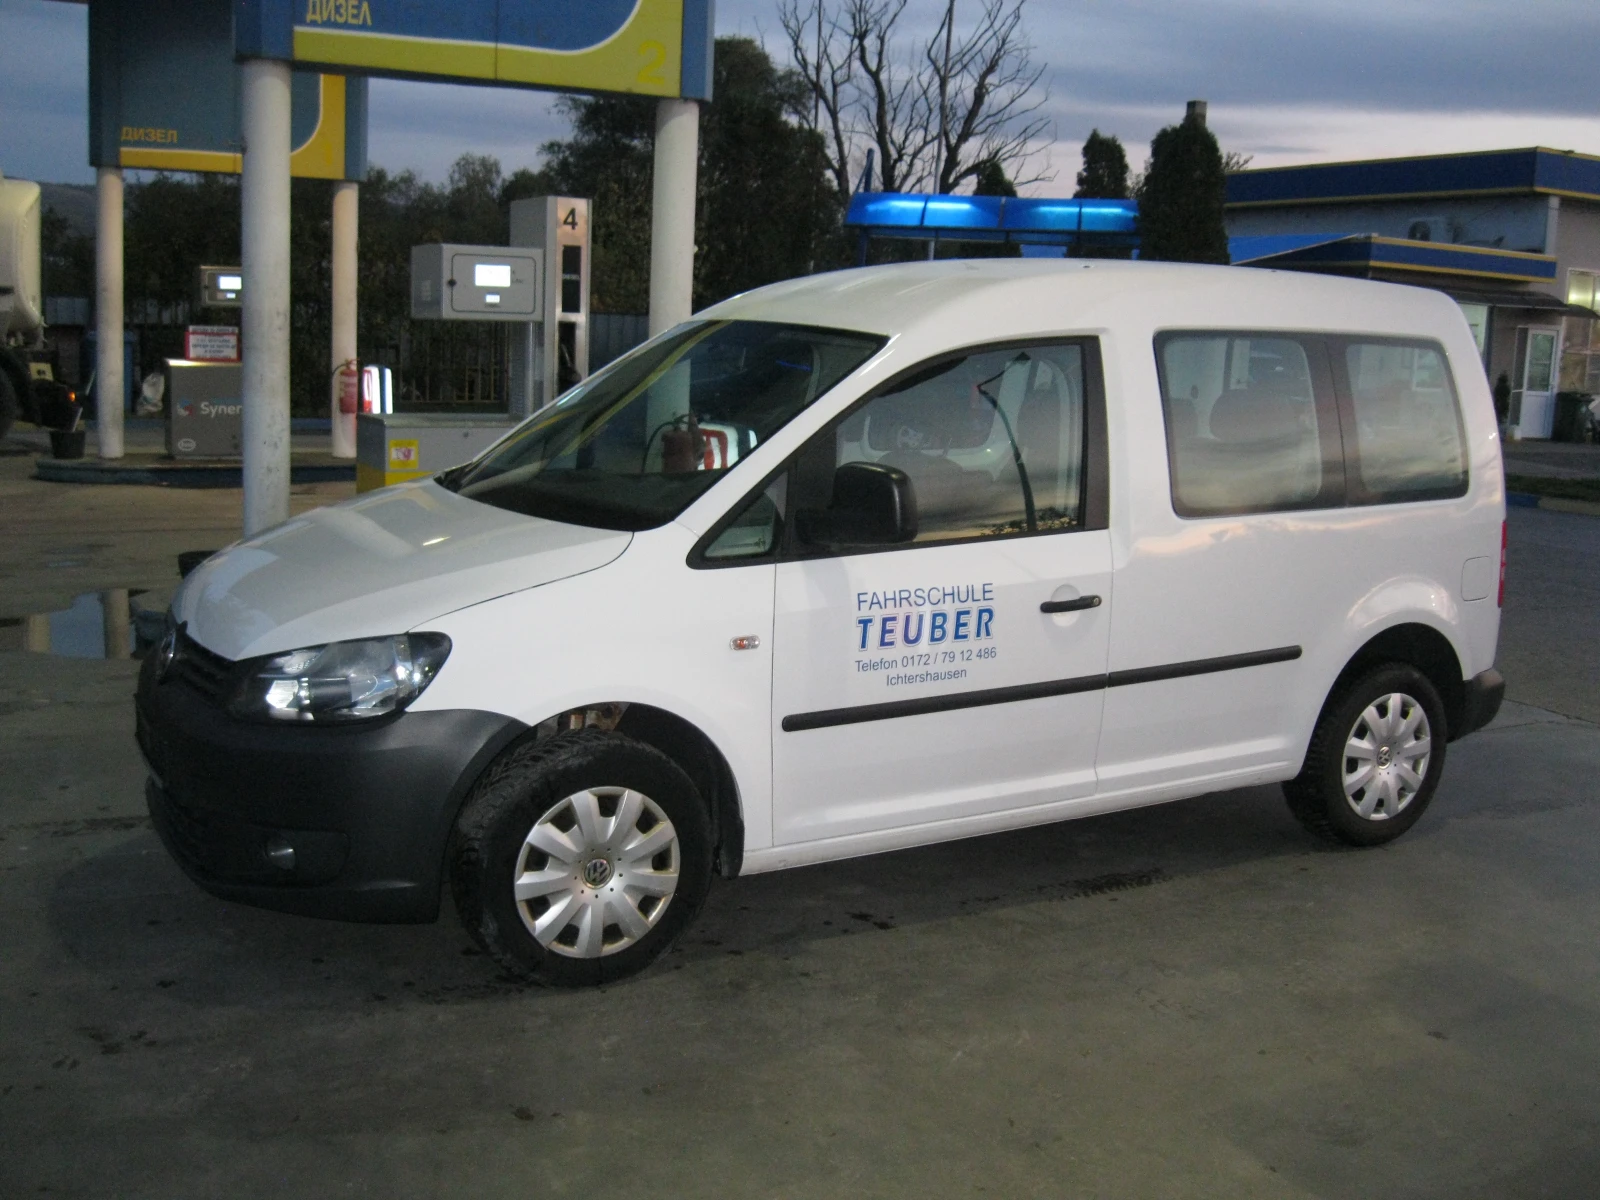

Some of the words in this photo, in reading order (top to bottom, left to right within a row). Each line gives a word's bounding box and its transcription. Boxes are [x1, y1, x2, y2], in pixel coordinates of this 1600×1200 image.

[306, 0, 372, 26] ДИЗЕЛ
[637, 39, 667, 85] 2
[121, 126, 178, 144] ДИЗЕЛ
[563, 207, 579, 231] 4
[857, 583, 994, 611] FAHRSCHULE
[856, 605, 995, 651] TEUBER
[855, 657, 898, 672] Telefon
[901, 653, 931, 668] 0172
[933, 652, 939, 664] /
[942, 651, 956, 663] 79
[960, 649, 973, 661] 12
[976, 646, 997, 660] 486
[886, 667, 967, 686] Ichtershausen
